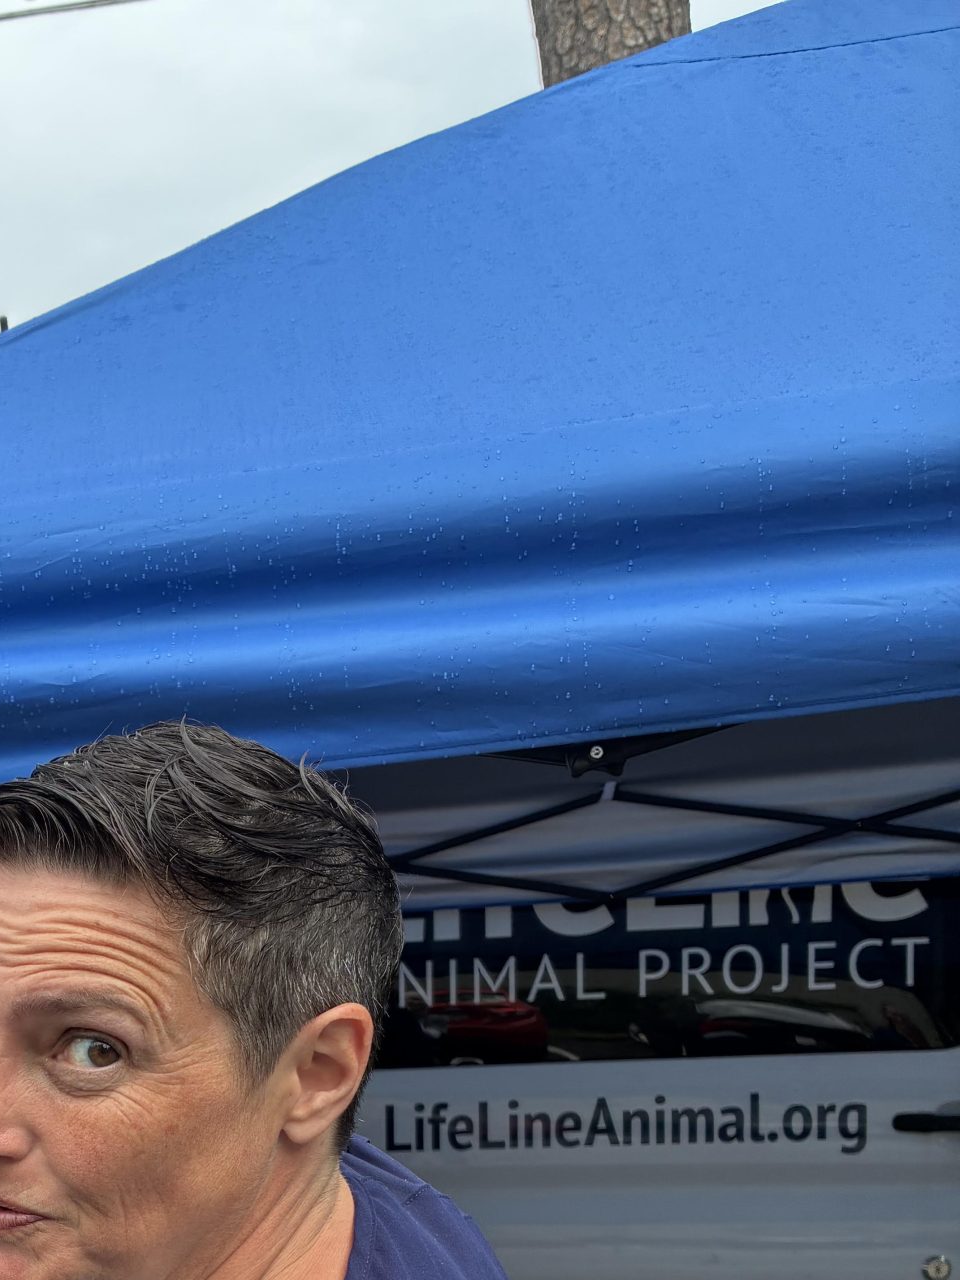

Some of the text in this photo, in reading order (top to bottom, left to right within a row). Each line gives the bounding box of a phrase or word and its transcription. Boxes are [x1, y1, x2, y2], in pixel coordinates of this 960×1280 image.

[398, 937, 931, 1008] NIMAL PROJECT
[384, 1093, 868, 1155] LifeLineAnimal.org
